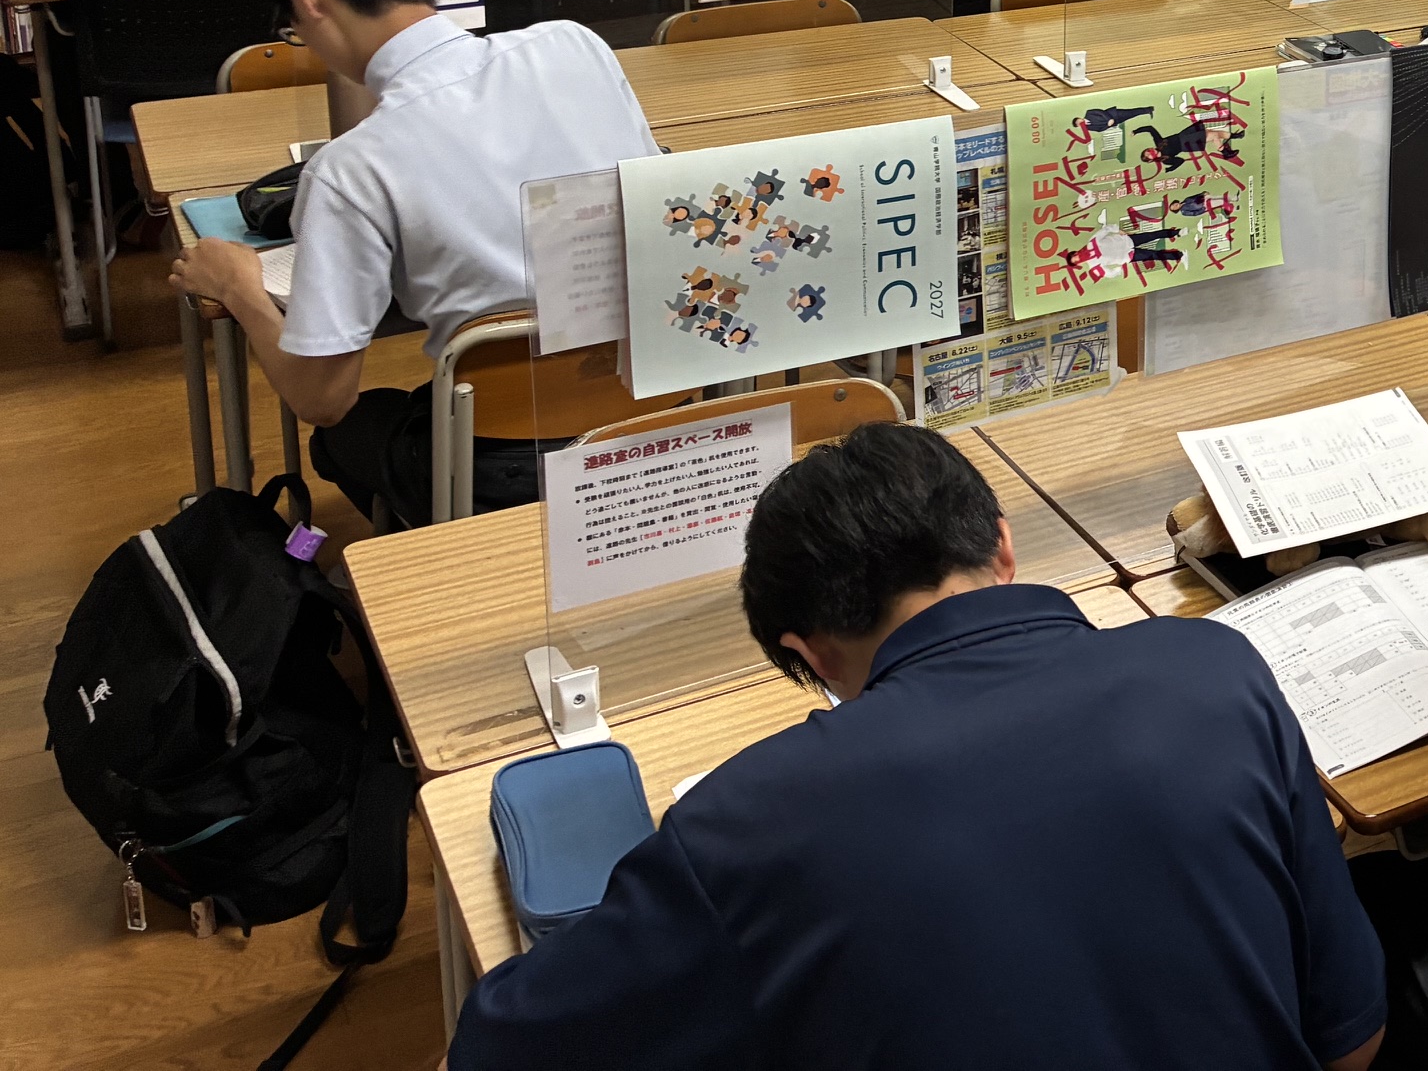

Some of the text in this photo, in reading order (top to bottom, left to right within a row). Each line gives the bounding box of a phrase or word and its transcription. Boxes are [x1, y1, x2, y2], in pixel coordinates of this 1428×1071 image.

[933, 146, 941, 183] 青山学院大学
[874, 159, 918, 314] SIPEC
[1032, 162, 1062, 295] HOSEI
[929, 281, 944, 319] 2027
[999, 335, 1013, 346] 大阪
[1058, 321, 1073, 331] 広島
[928, 350, 948, 363] 名古屋
[584, 421, 753, 471] 進路室の自習スペース開放
